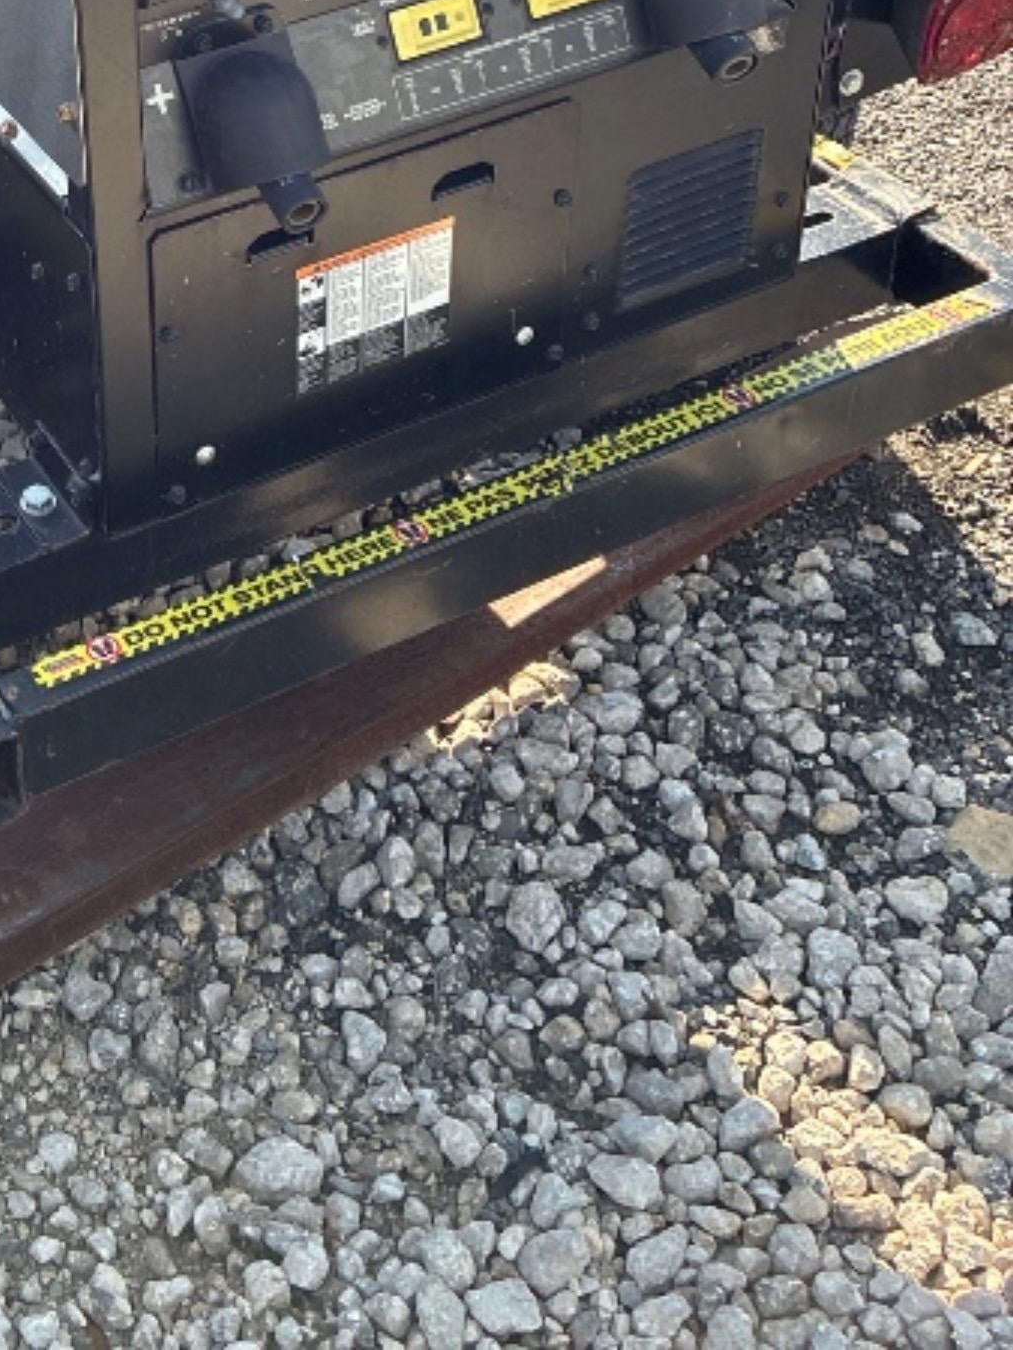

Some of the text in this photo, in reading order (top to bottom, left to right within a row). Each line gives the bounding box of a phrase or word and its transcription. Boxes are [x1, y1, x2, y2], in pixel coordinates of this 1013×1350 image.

[751, 371, 787, 396] NO
[122, 621, 164, 648] DO
[170, 596, 229, 629] NOT
[324, 529, 395, 569] HERE
